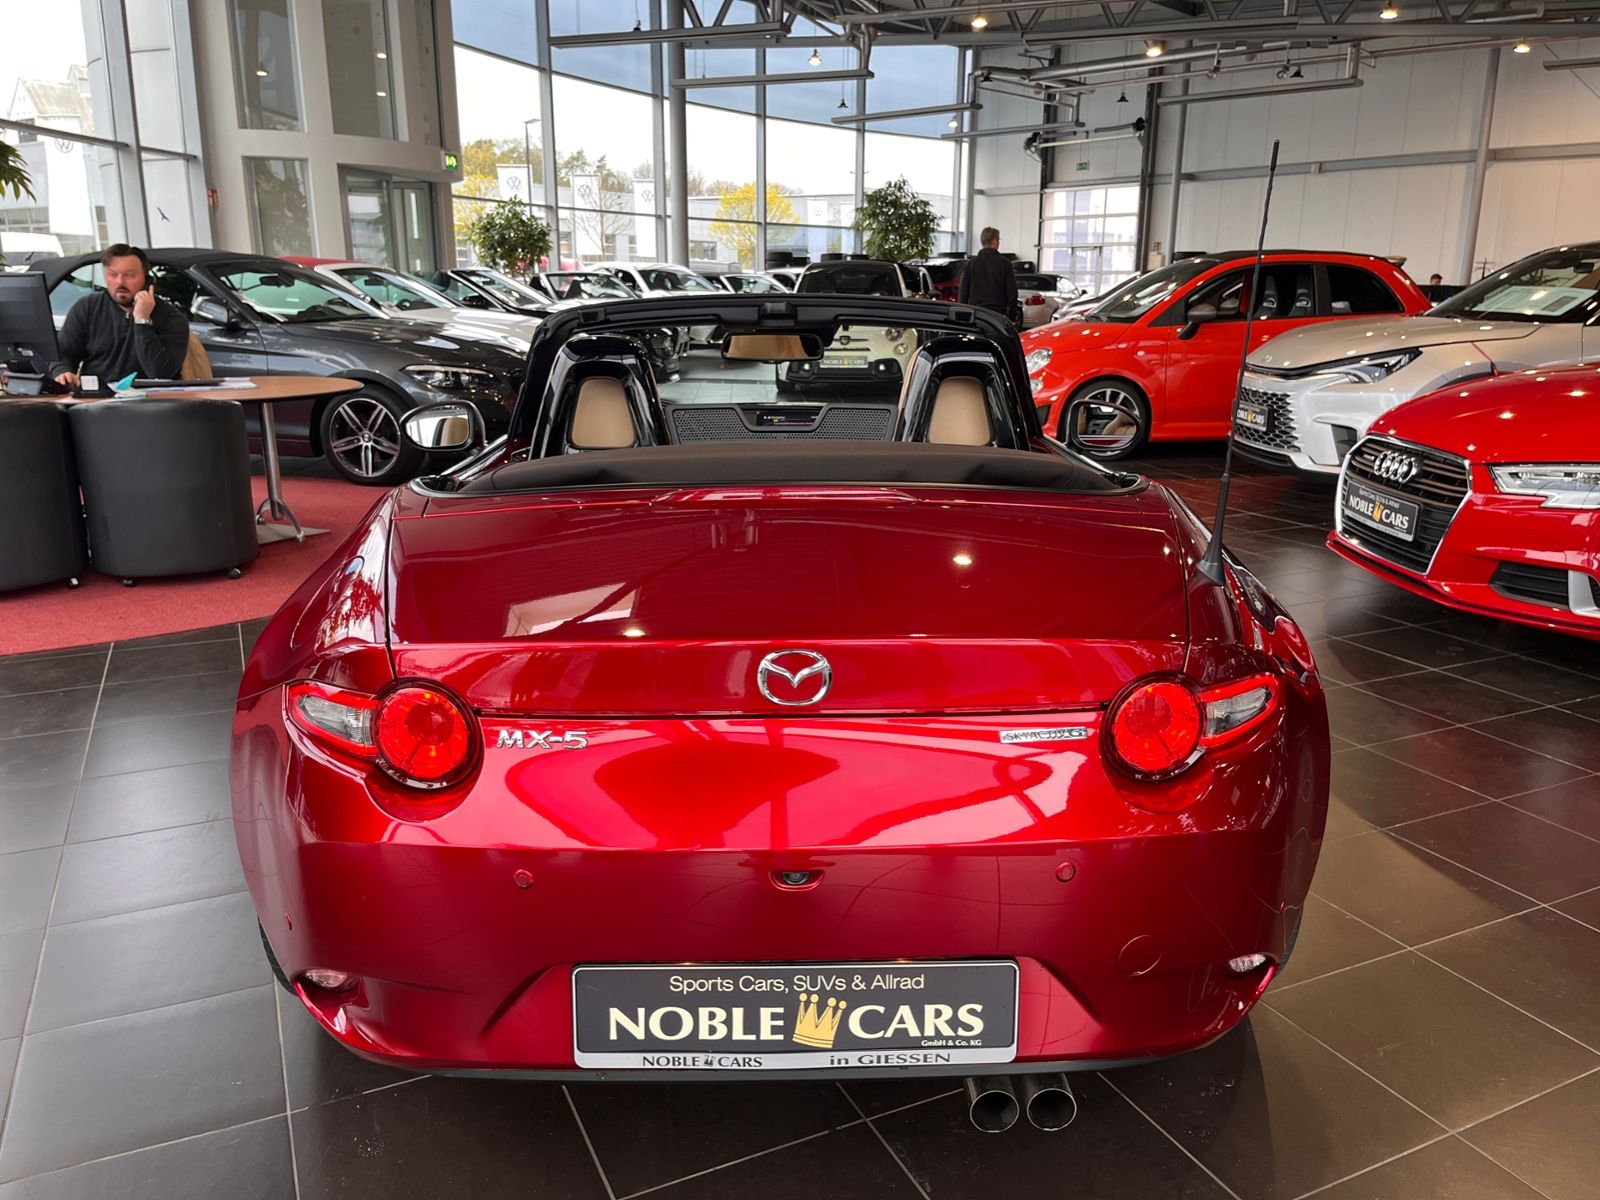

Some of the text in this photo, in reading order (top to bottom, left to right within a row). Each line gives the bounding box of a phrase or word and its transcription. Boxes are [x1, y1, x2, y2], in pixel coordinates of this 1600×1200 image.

[1349, 494, 1374, 516] NOBLE
[1381, 508, 1409, 529] CARS
[497, 729, 588, 750] MX-5
[669, 974, 925, 995] Sports Cars, SUVs & Allrad
[609, 1003, 984, 1041] NOBLE CARS
[921, 1039, 946, 1047] GmbH
[642, 1056, 763, 1068] NOBLE CARS
[830, 1053, 951, 1066] in GIESSEN
